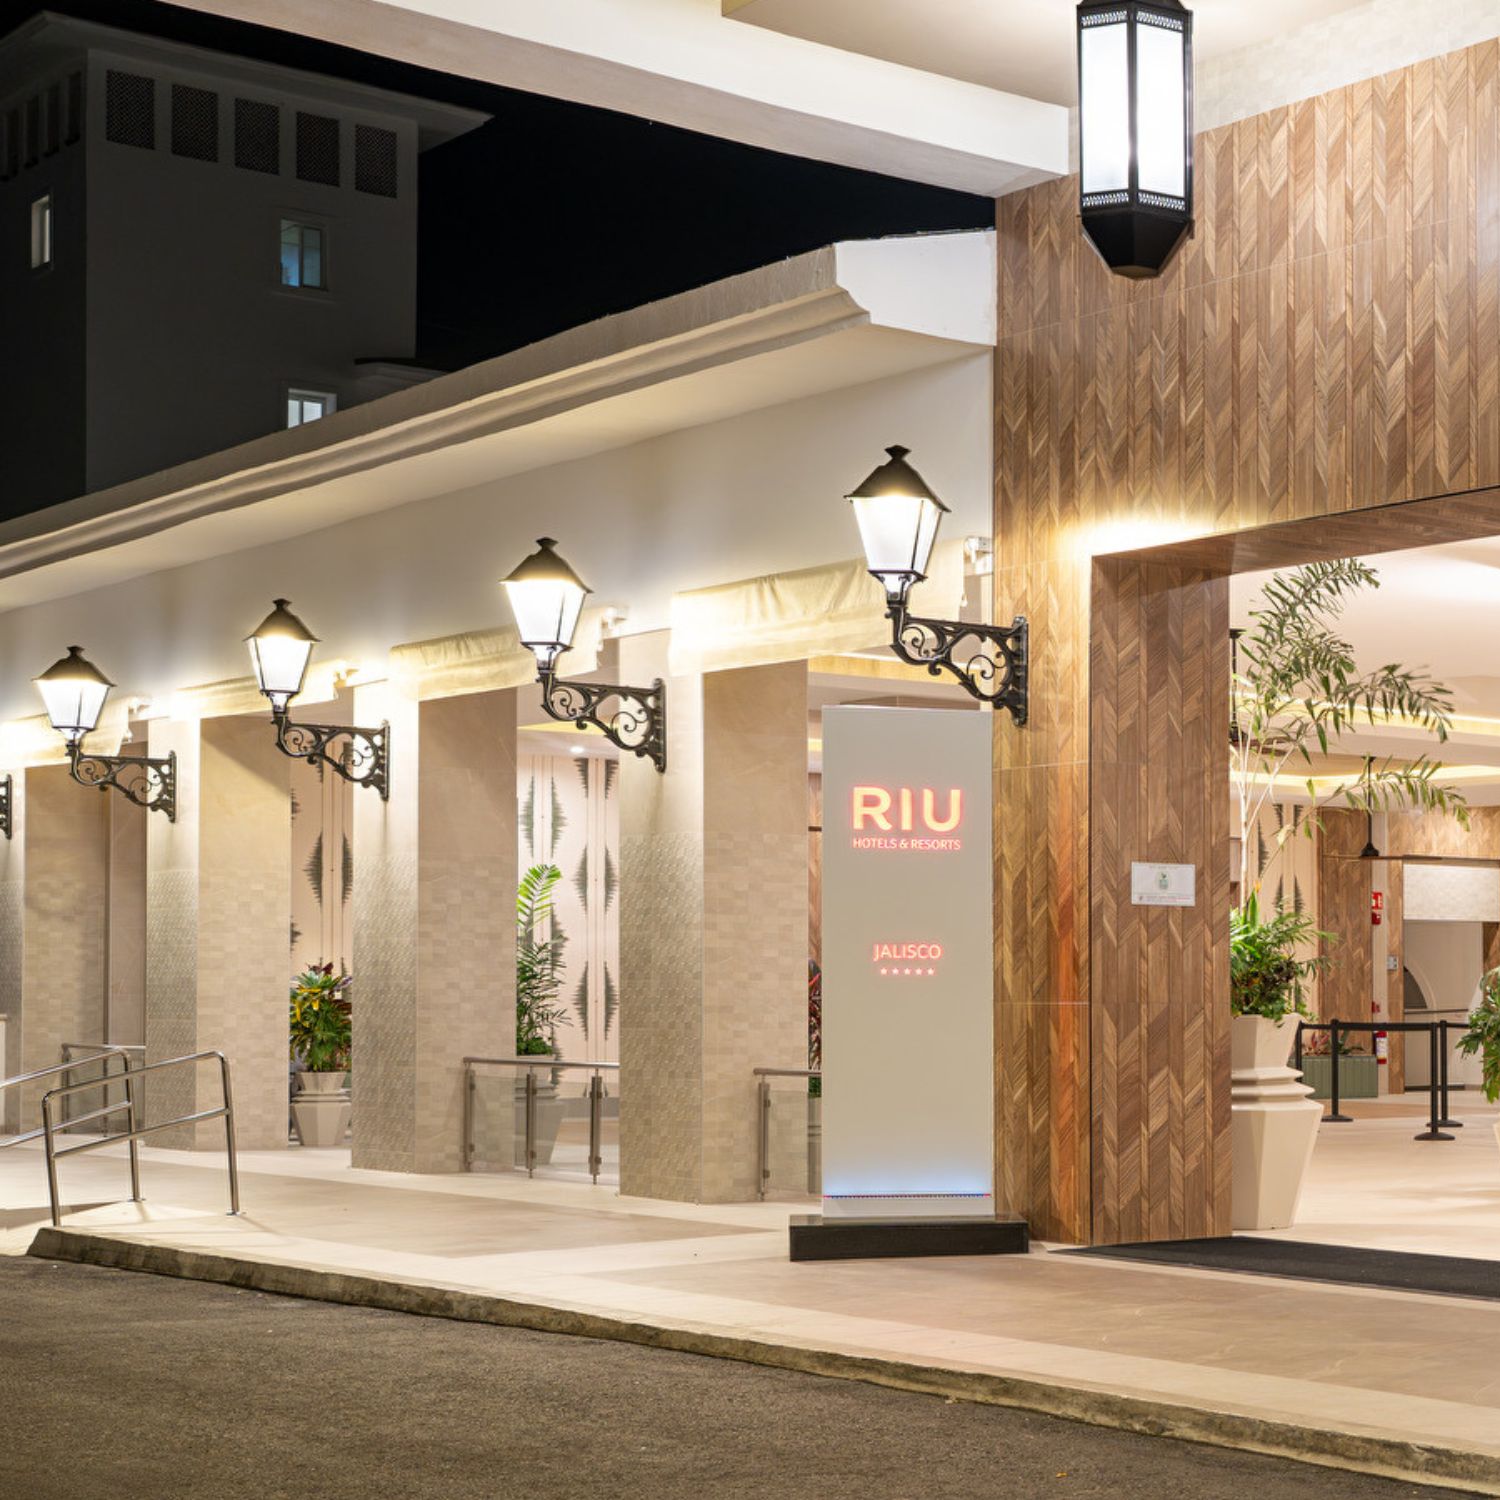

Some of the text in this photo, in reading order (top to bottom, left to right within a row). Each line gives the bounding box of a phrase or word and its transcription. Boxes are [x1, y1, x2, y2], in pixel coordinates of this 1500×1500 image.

[853, 786, 961, 832] RIU
[853, 838, 961, 850] HOTELS & RESORTS
[873, 944, 942, 961] JALISCO
